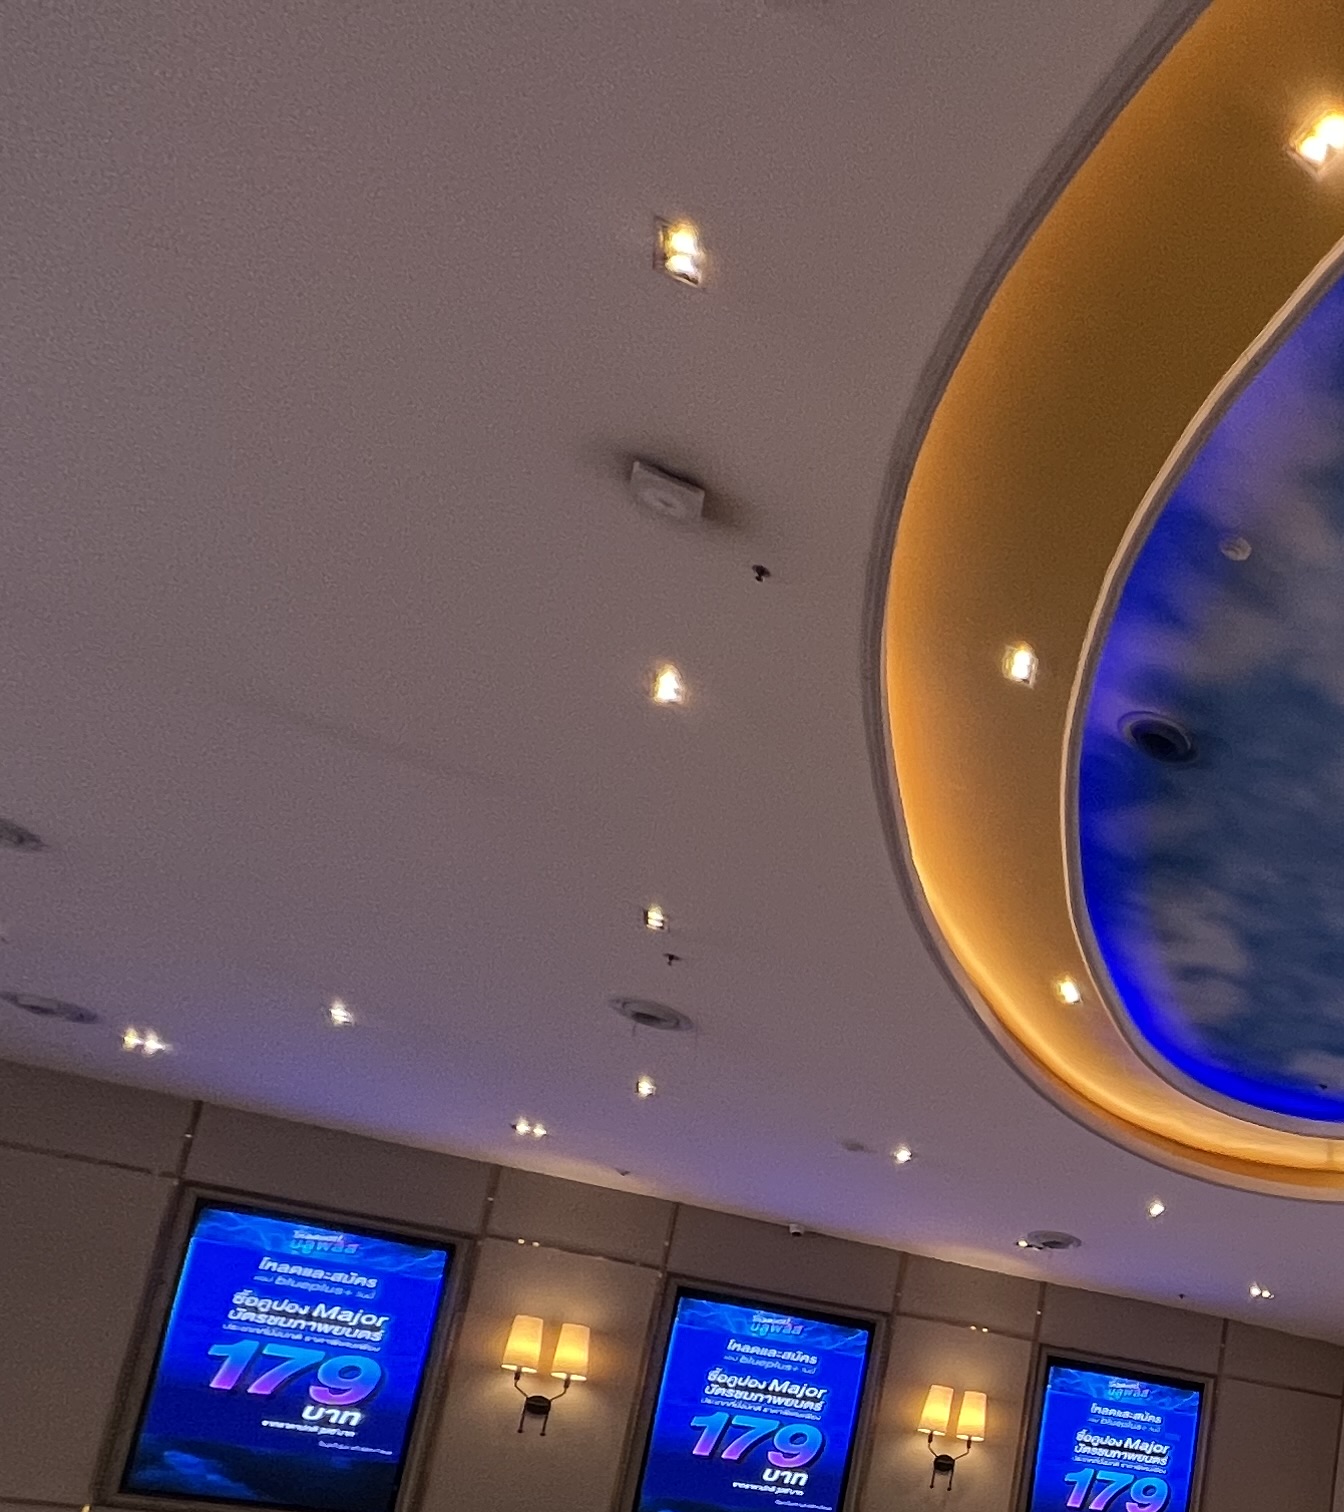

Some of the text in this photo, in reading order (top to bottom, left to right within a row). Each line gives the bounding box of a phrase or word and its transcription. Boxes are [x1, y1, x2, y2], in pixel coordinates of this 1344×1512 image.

[311, 1302, 389, 1328] Major
[207, 1338, 382, 1406] 179
[768, 1379, 828, 1399] Major
[301, 1404, 362, 1427] บาท
[690, 1411, 823, 1468] 179
[1124, 1437, 1170, 1454] Major
[763, 1468, 809, 1486] บาท
